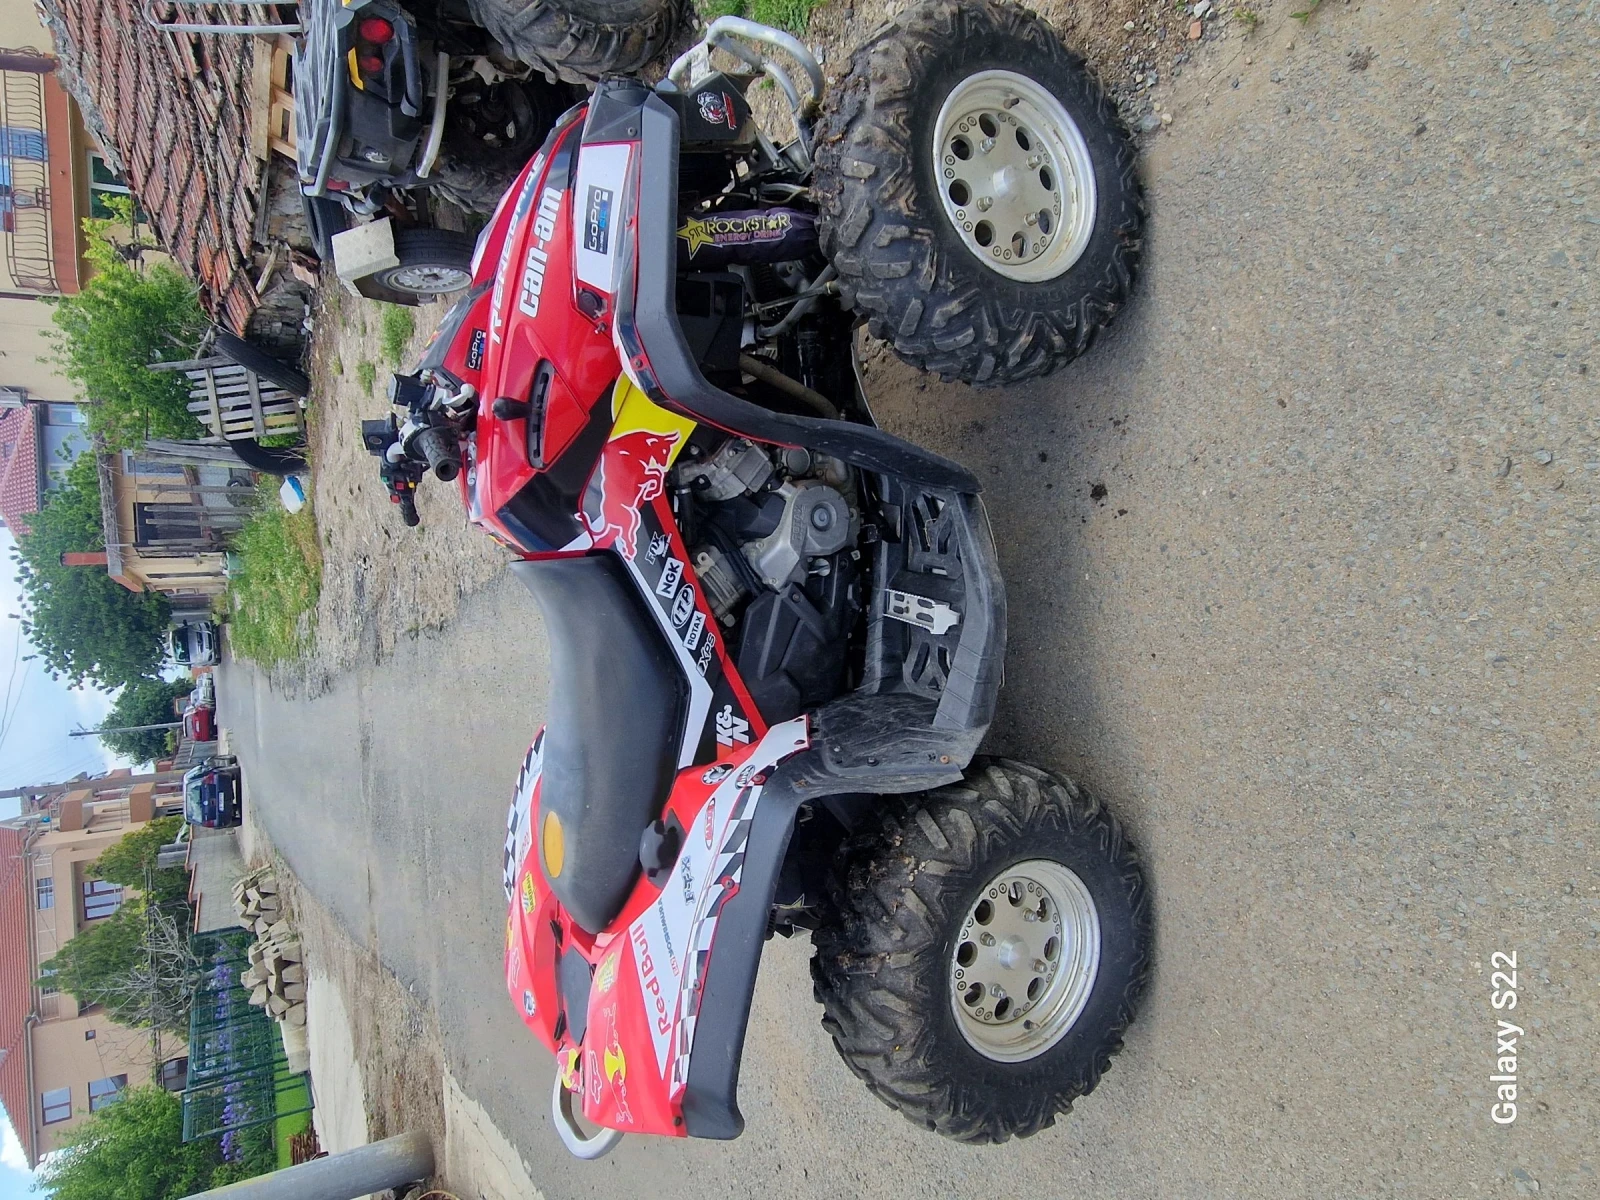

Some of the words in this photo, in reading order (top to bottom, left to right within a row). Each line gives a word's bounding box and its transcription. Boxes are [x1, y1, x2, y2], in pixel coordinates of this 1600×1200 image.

[588, 188, 602, 250] GoPro
[714, 232, 753, 242] ENERGY
[754, 228, 782, 238] DRINK
[468, 330, 482, 369] GoPro
[661, 561, 680, 594] NGK
[674, 588, 690, 624] ITP
[688, 615, 703, 646] ROTAX
[698, 632, 716, 665] XPS
[632, 923, 656, 978] Bull
[644, 976, 672, 1036] Red
